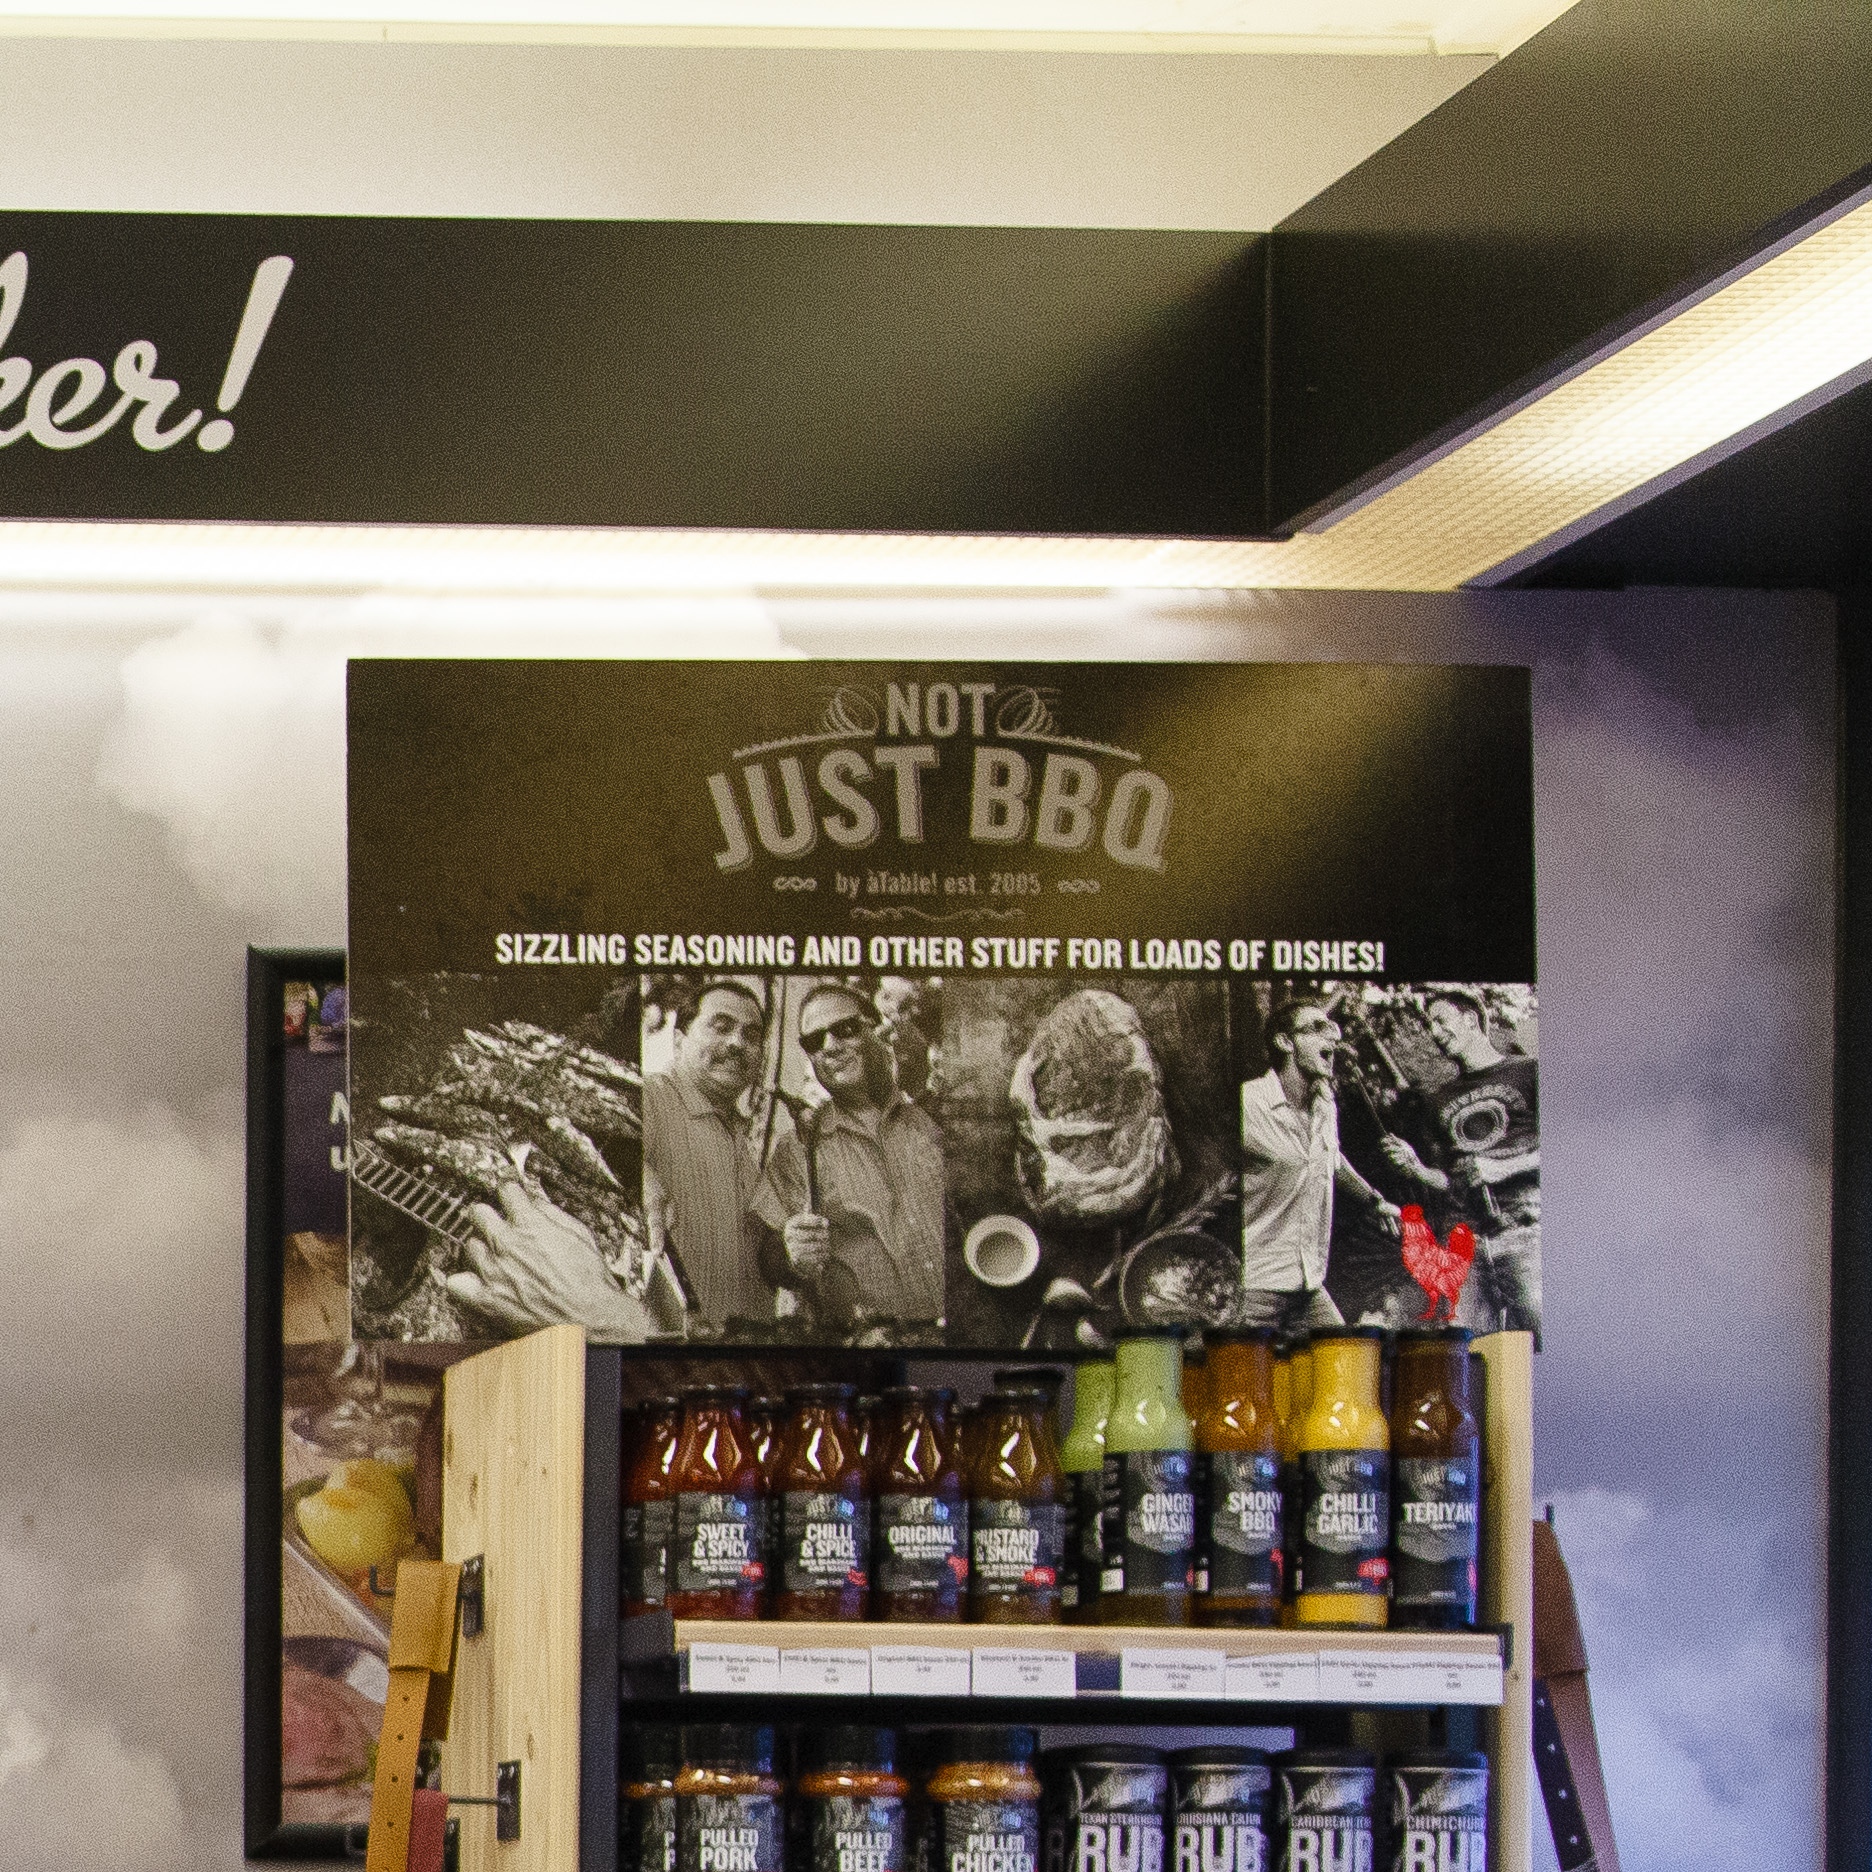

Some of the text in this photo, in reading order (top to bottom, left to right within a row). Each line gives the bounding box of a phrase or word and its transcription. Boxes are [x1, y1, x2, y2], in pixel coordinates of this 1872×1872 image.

[885, 683, 997, 738] NOT
[706, 746, 1173, 874] JUST BBQ
[836, 873, 861, 898] by
[944, 875, 980, 895] est.
[496, 932, 1385, 972] SIZZLING SEASONING AND OTHER STUFF FOR LOADS OF DISHES!
[1320, 1493, 1376, 1513] CHILLI
[697, 1523, 746, 1541] SWEET
[806, 1523, 853, 1541] CHILLI
[1318, 1513, 1378, 1534] GARLIC
[889, 1526, 955, 1547] ORIGINAL
[707, 1540, 750, 1558] SPICY
[816, 1540, 856, 1558] SPICE
[700, 1829, 759, 1847] PULLED
[700, 1847, 757, 1872] PORK
[839, 1850, 888, 1872] BEEF
